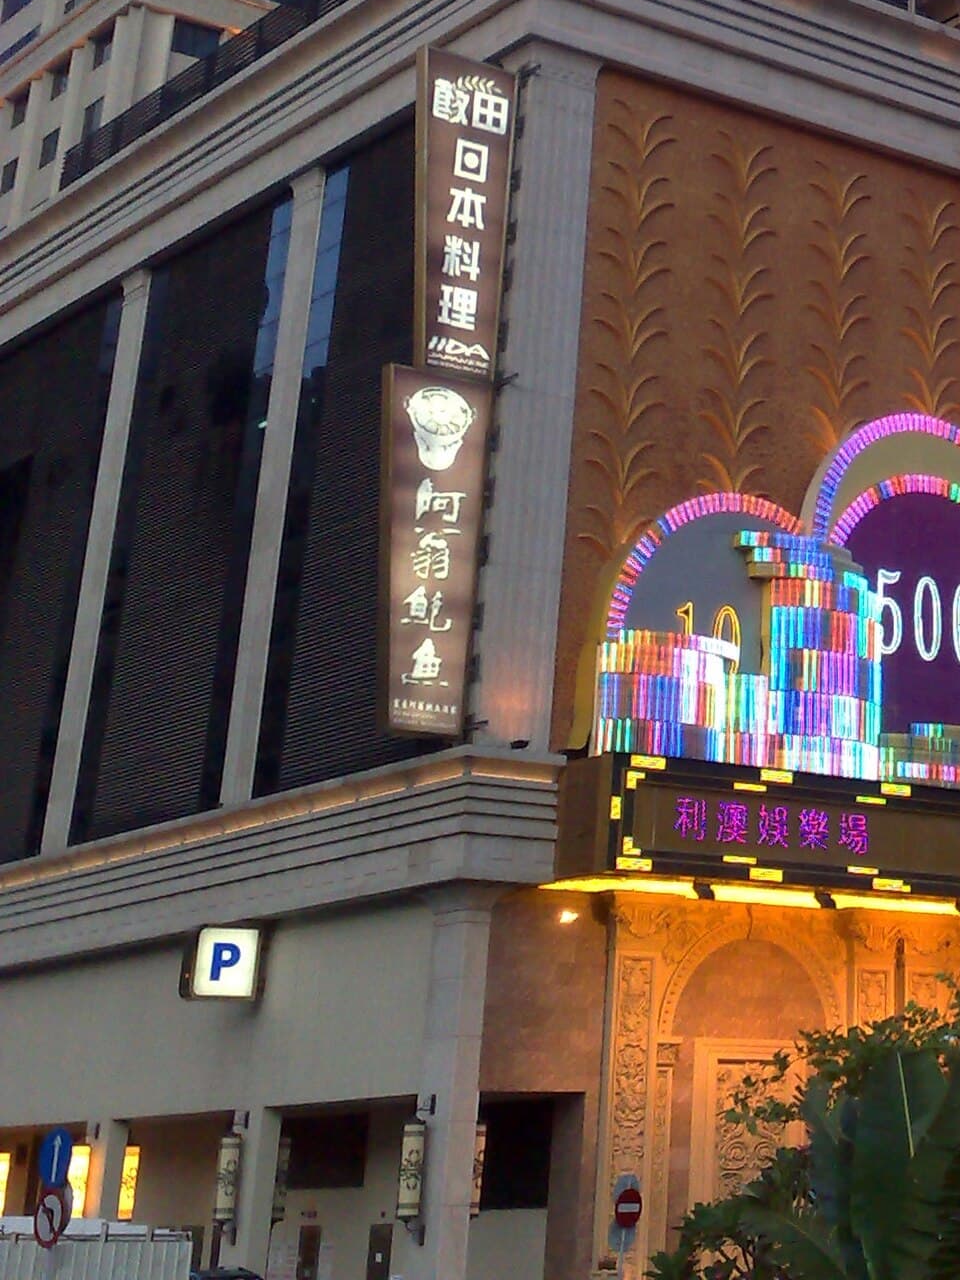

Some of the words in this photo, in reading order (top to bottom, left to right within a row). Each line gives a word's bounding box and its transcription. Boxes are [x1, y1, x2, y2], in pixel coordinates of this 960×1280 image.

[437, 138, 489, 332] 日本料理
[209, 942, 241, 981] P
